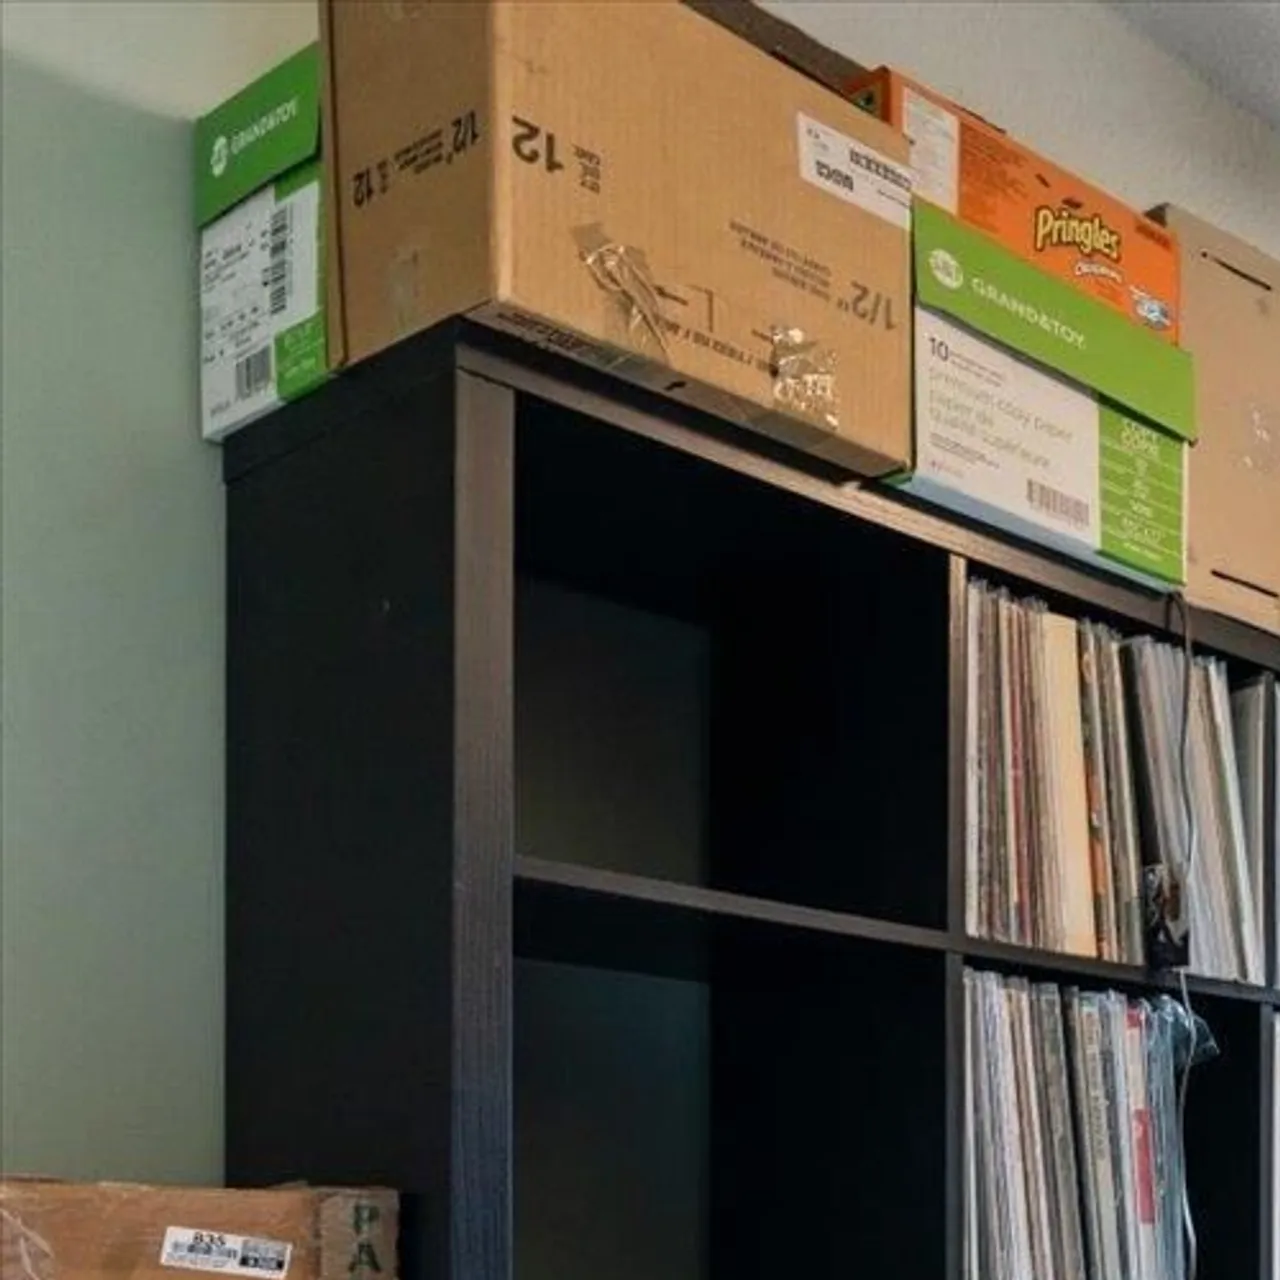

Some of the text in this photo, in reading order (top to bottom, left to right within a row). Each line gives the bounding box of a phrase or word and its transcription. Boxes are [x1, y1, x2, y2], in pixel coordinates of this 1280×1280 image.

[511, 115, 565, 174] 12
[352, 168, 374, 208] 12
[1035, 206, 1121, 262] Pringles
[929, 337, 949, 361] 10
